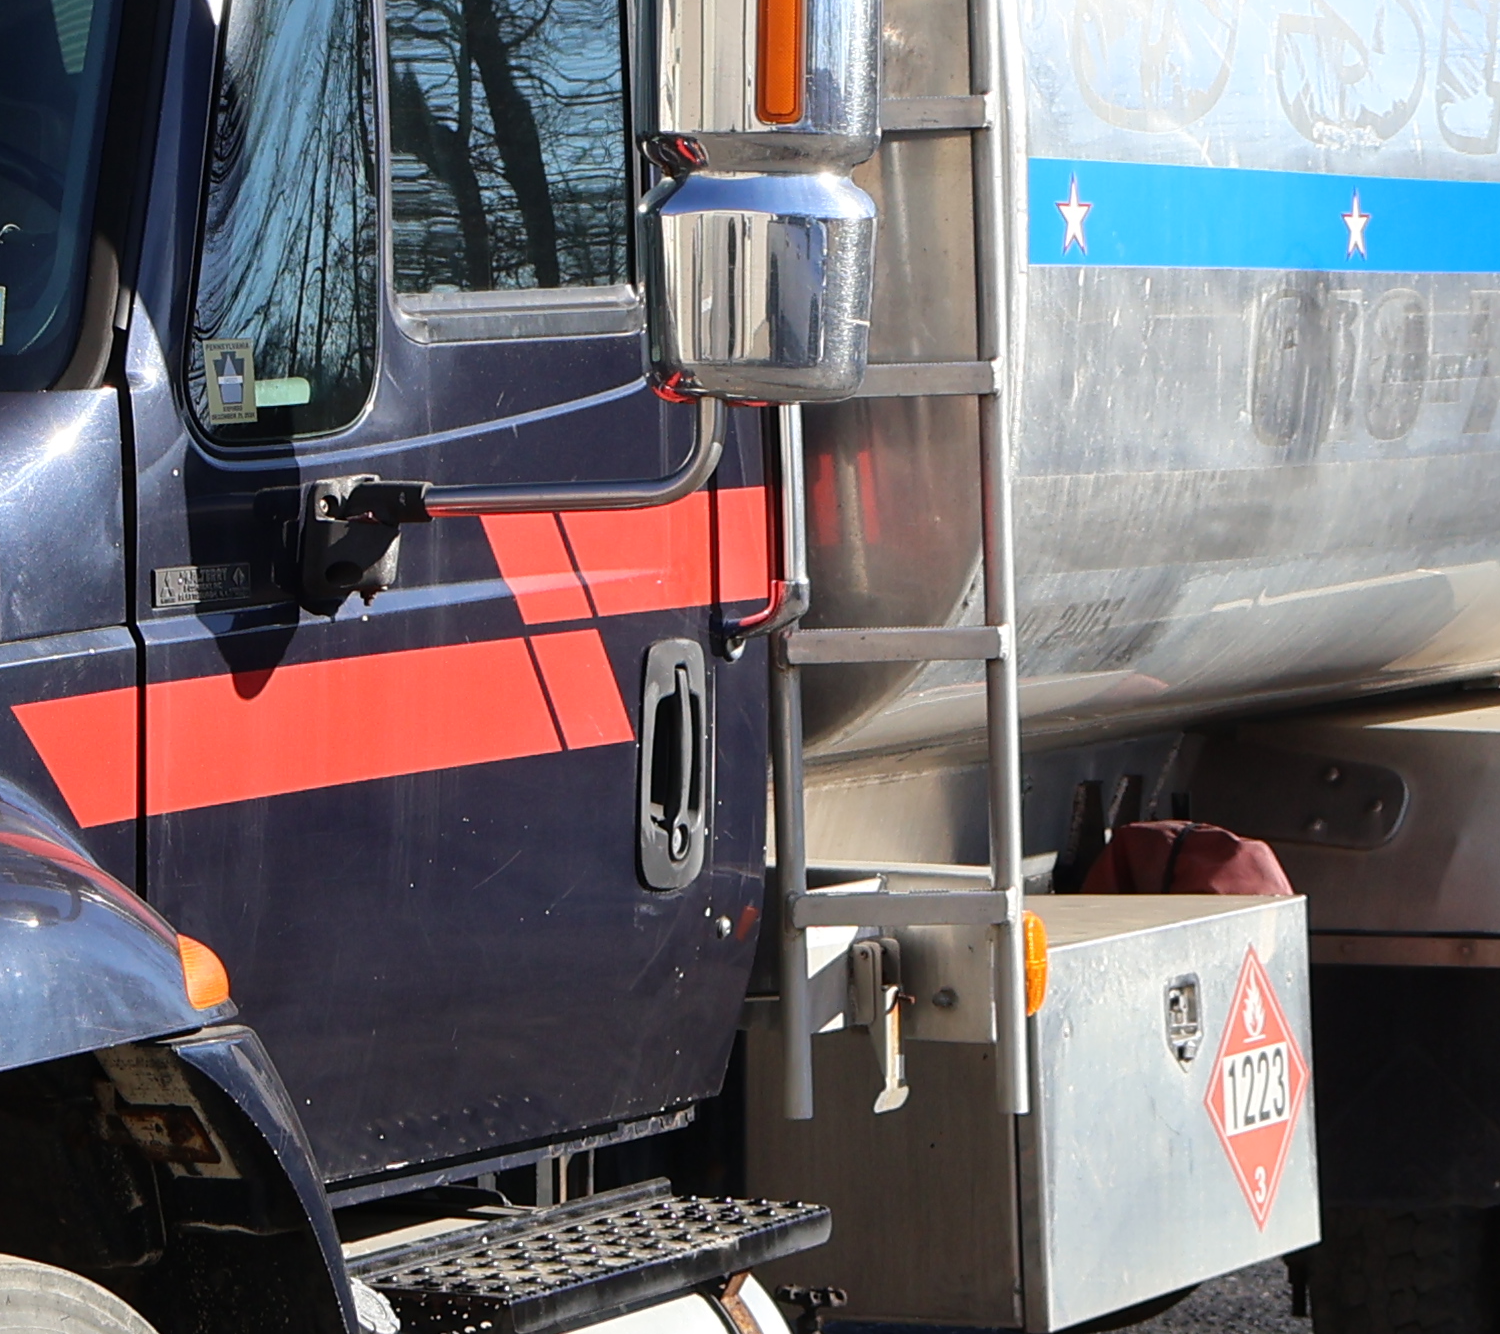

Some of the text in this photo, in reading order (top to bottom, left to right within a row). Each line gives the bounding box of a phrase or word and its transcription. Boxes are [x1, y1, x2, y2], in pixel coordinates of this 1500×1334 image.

[205, 342, 250, 351] PENNSYLVANIA
[1227, 1047, 1287, 1130] 1223
[1253, 1165, 1267, 1204] 3
